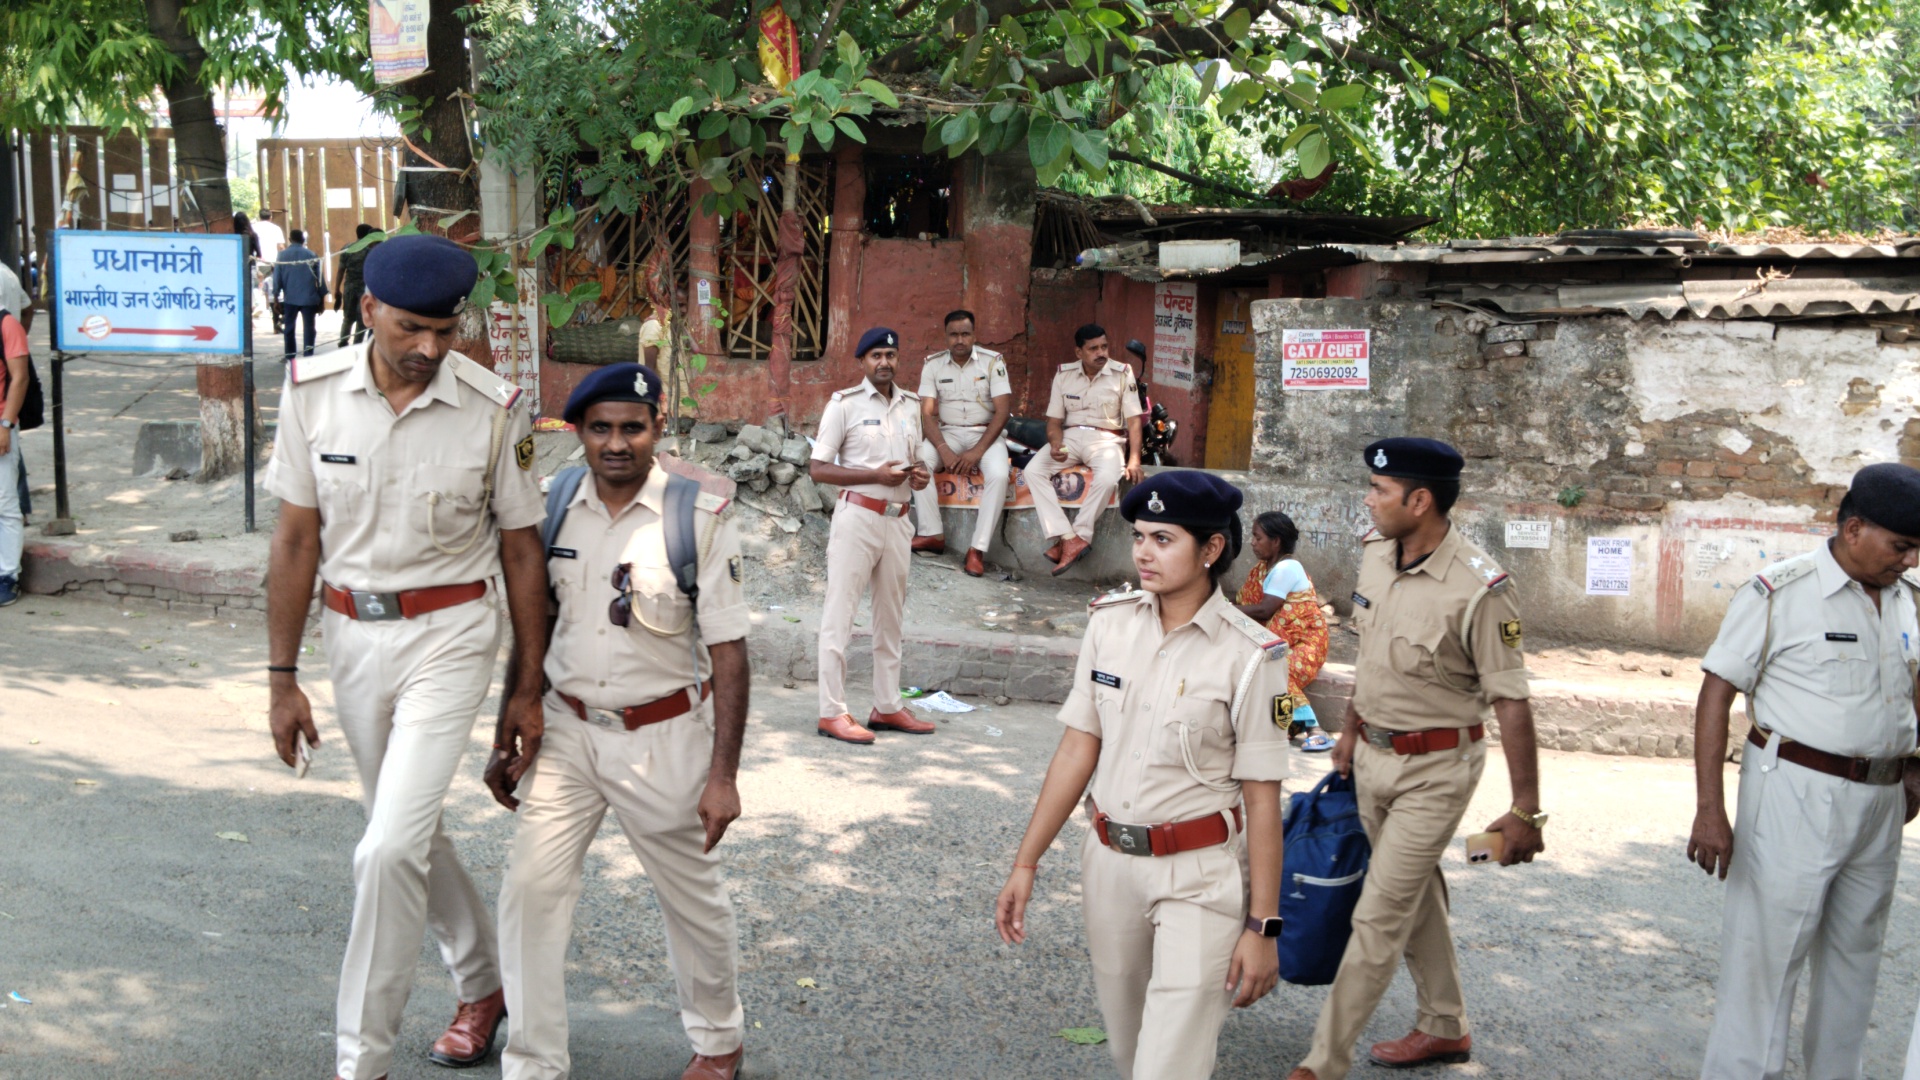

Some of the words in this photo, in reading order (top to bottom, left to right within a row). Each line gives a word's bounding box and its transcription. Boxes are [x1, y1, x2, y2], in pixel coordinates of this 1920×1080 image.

[92, 244, 203, 274] प्रधानमंत्री
[65, 285, 118, 310] भारतीय
[122, 292, 149, 308] जन
[204, 287, 236, 314] केन्द्र
[1163, 290, 1194, 313] पेन्टर
[1288, 345, 1316, 358] CAT
[1327, 344, 1362, 358] CUET
[1290, 367, 1358, 378] 7250692092
[1591, 539, 1611, 547] WORK
[1612, 539, 1631, 547] FROM
[1598, 547, 1623, 555] HOME
[1591, 579, 1628, 588] 9470217262
